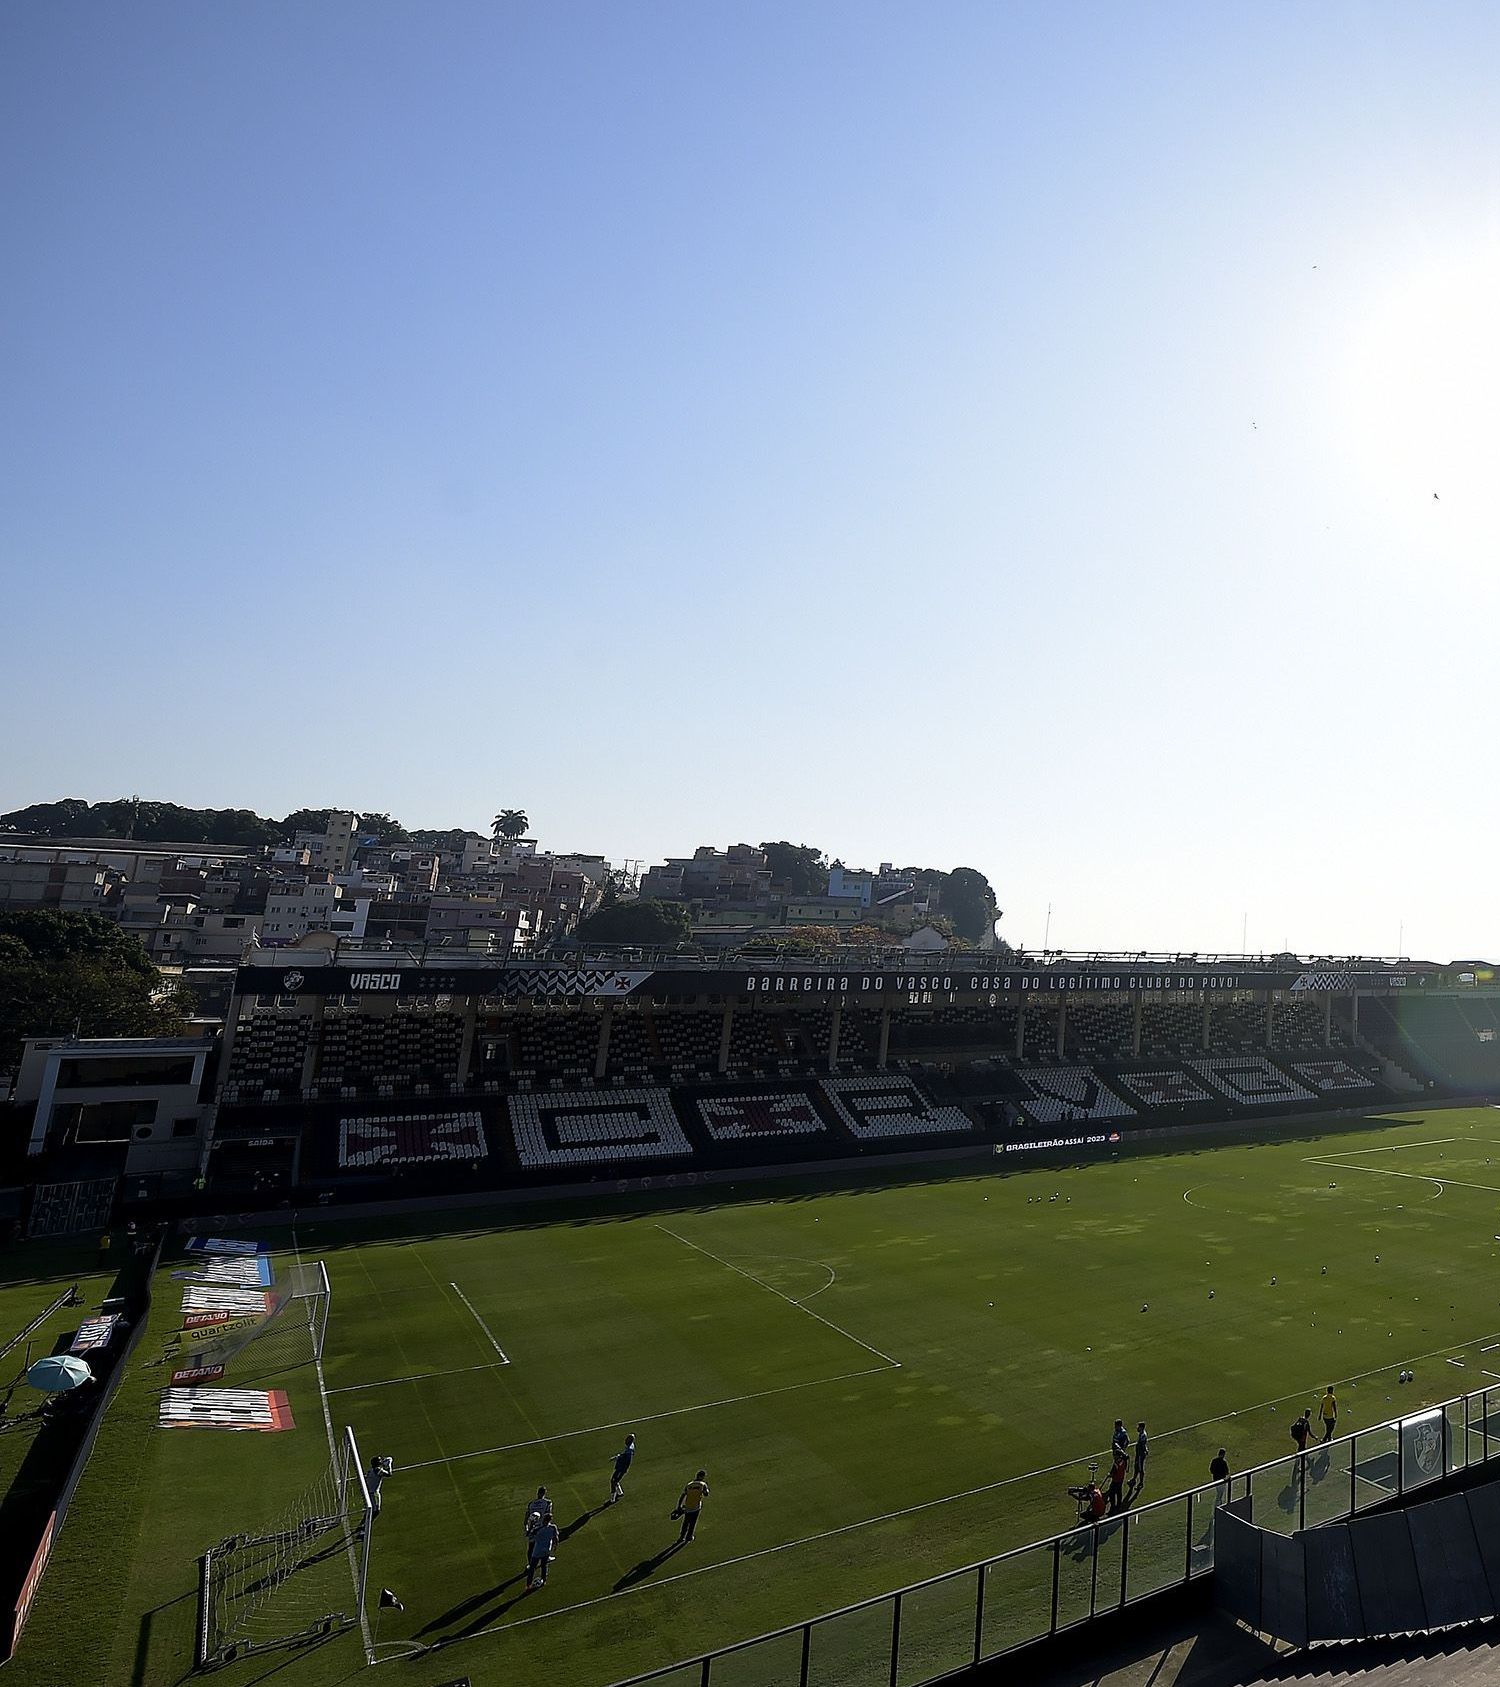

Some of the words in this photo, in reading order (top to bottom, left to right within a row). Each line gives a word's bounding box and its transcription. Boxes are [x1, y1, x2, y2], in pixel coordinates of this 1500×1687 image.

[350, 973, 400, 990] VASCO
[862, 976, 883, 990] DO
[1022, 977, 1040, 990] DO
[1179, 978, 1194, 989] DO
[1086, 1135, 1106, 1143] 2023
[186, 1312, 228, 1324] BETANO
[191, 1318, 257, 1339] quartzolit
[174, 1365, 223, 1379] BETANO
